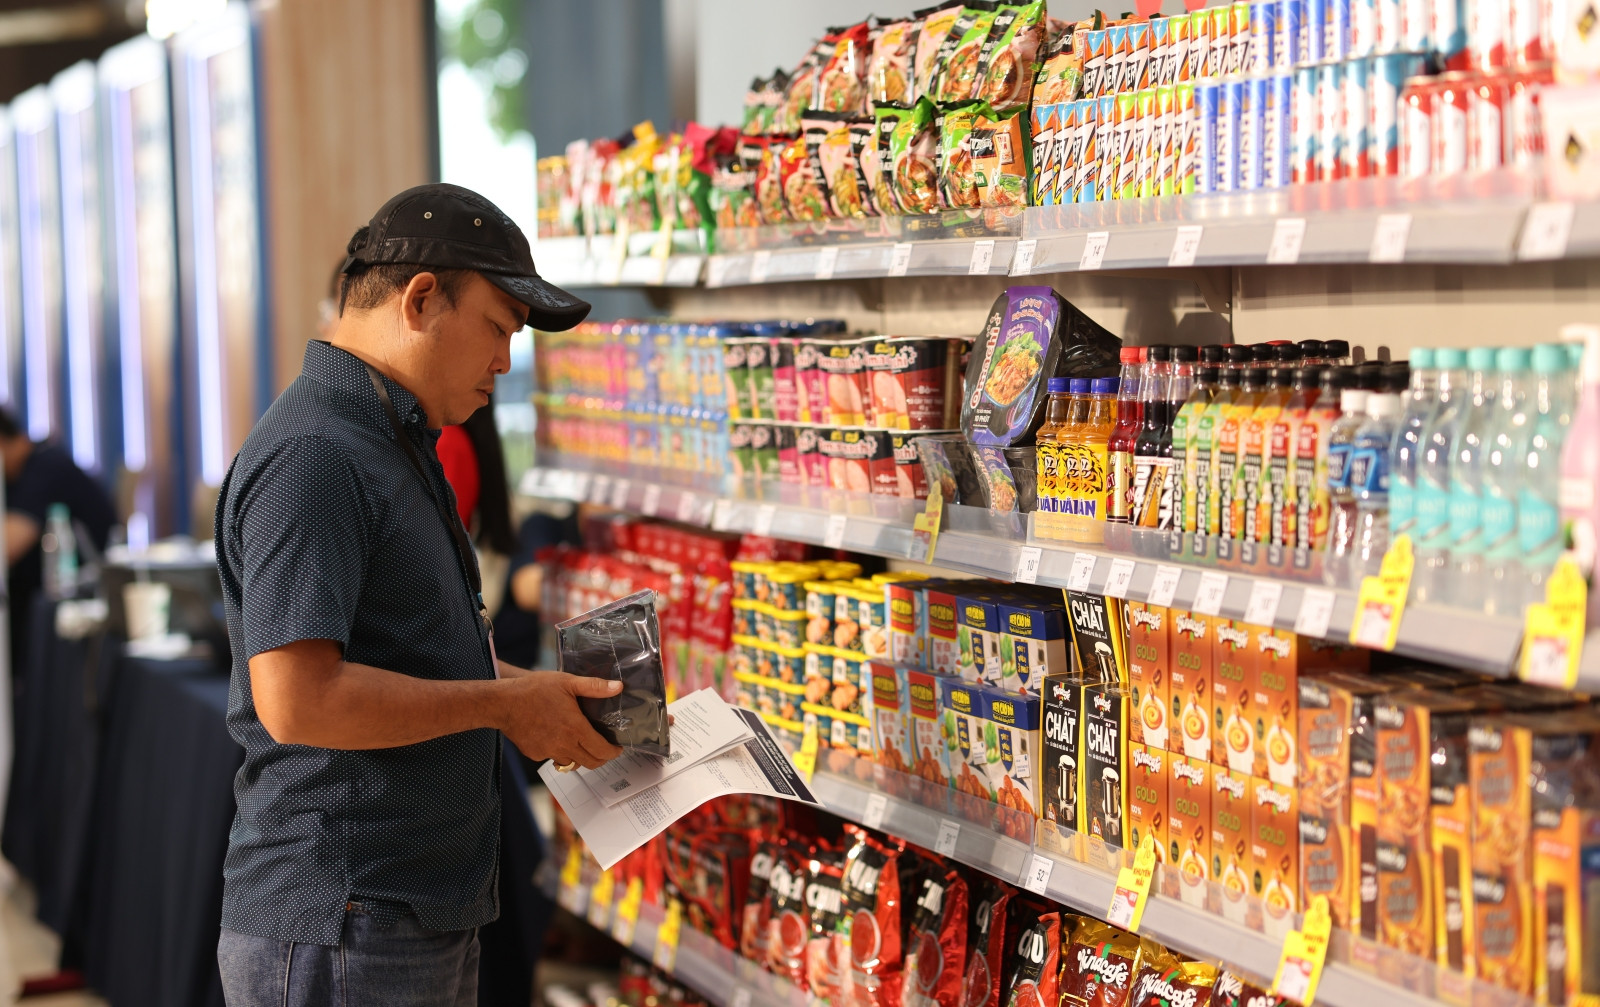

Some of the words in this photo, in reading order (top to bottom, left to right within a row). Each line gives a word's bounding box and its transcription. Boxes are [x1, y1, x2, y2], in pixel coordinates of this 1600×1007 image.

[1136, 644, 1157, 661] GOLD
[1178, 652, 1202, 670] GOLD
[1136, 785, 1157, 804] GOLD
[1131, 804, 1142, 815] 100%
[1176, 798, 1199, 817] GOLD
[1077, 948, 1130, 990] Vinacafé
